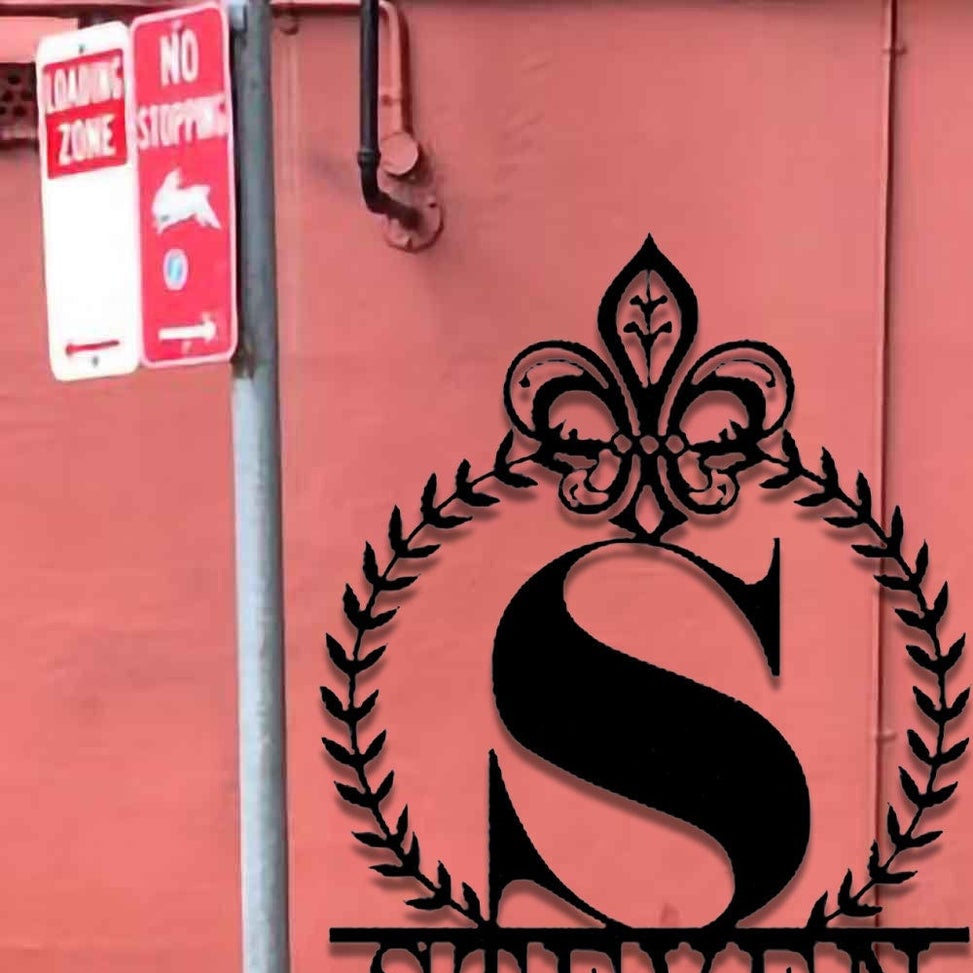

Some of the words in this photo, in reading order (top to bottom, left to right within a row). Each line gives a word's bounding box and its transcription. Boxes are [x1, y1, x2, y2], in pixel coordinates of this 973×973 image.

[44, 56, 123, 113] LOADING
[159, 28, 198, 86] NO
[58, 114, 116, 166] ZONE
[490, 537, 812, 928] S
